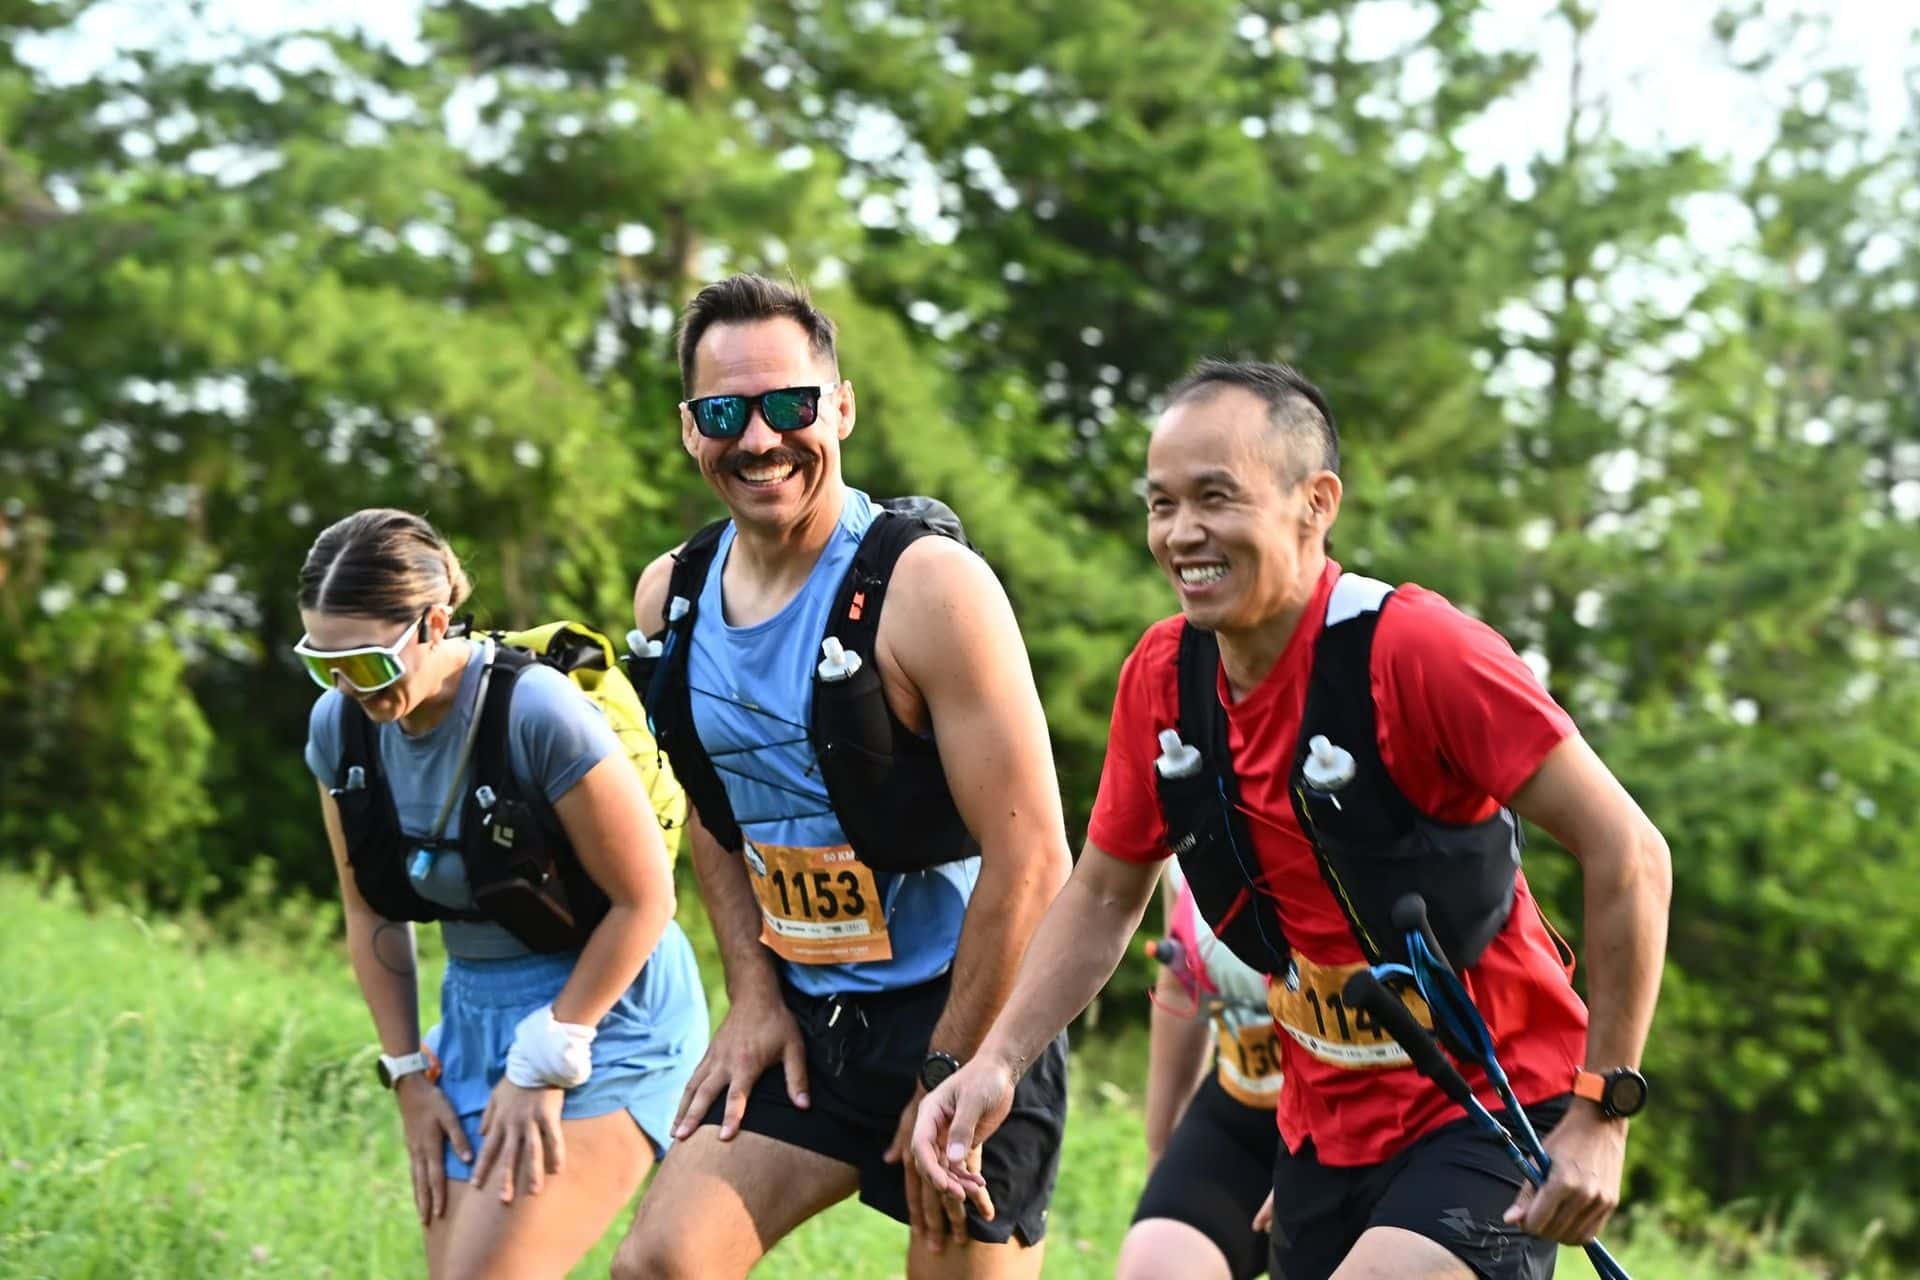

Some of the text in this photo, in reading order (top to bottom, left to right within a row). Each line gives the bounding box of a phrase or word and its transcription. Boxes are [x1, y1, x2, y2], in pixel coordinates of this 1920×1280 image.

[772, 870, 865, 918] 1153
[1305, 987, 1384, 1041] 114
[1237, 1031, 1280, 1078] 130
